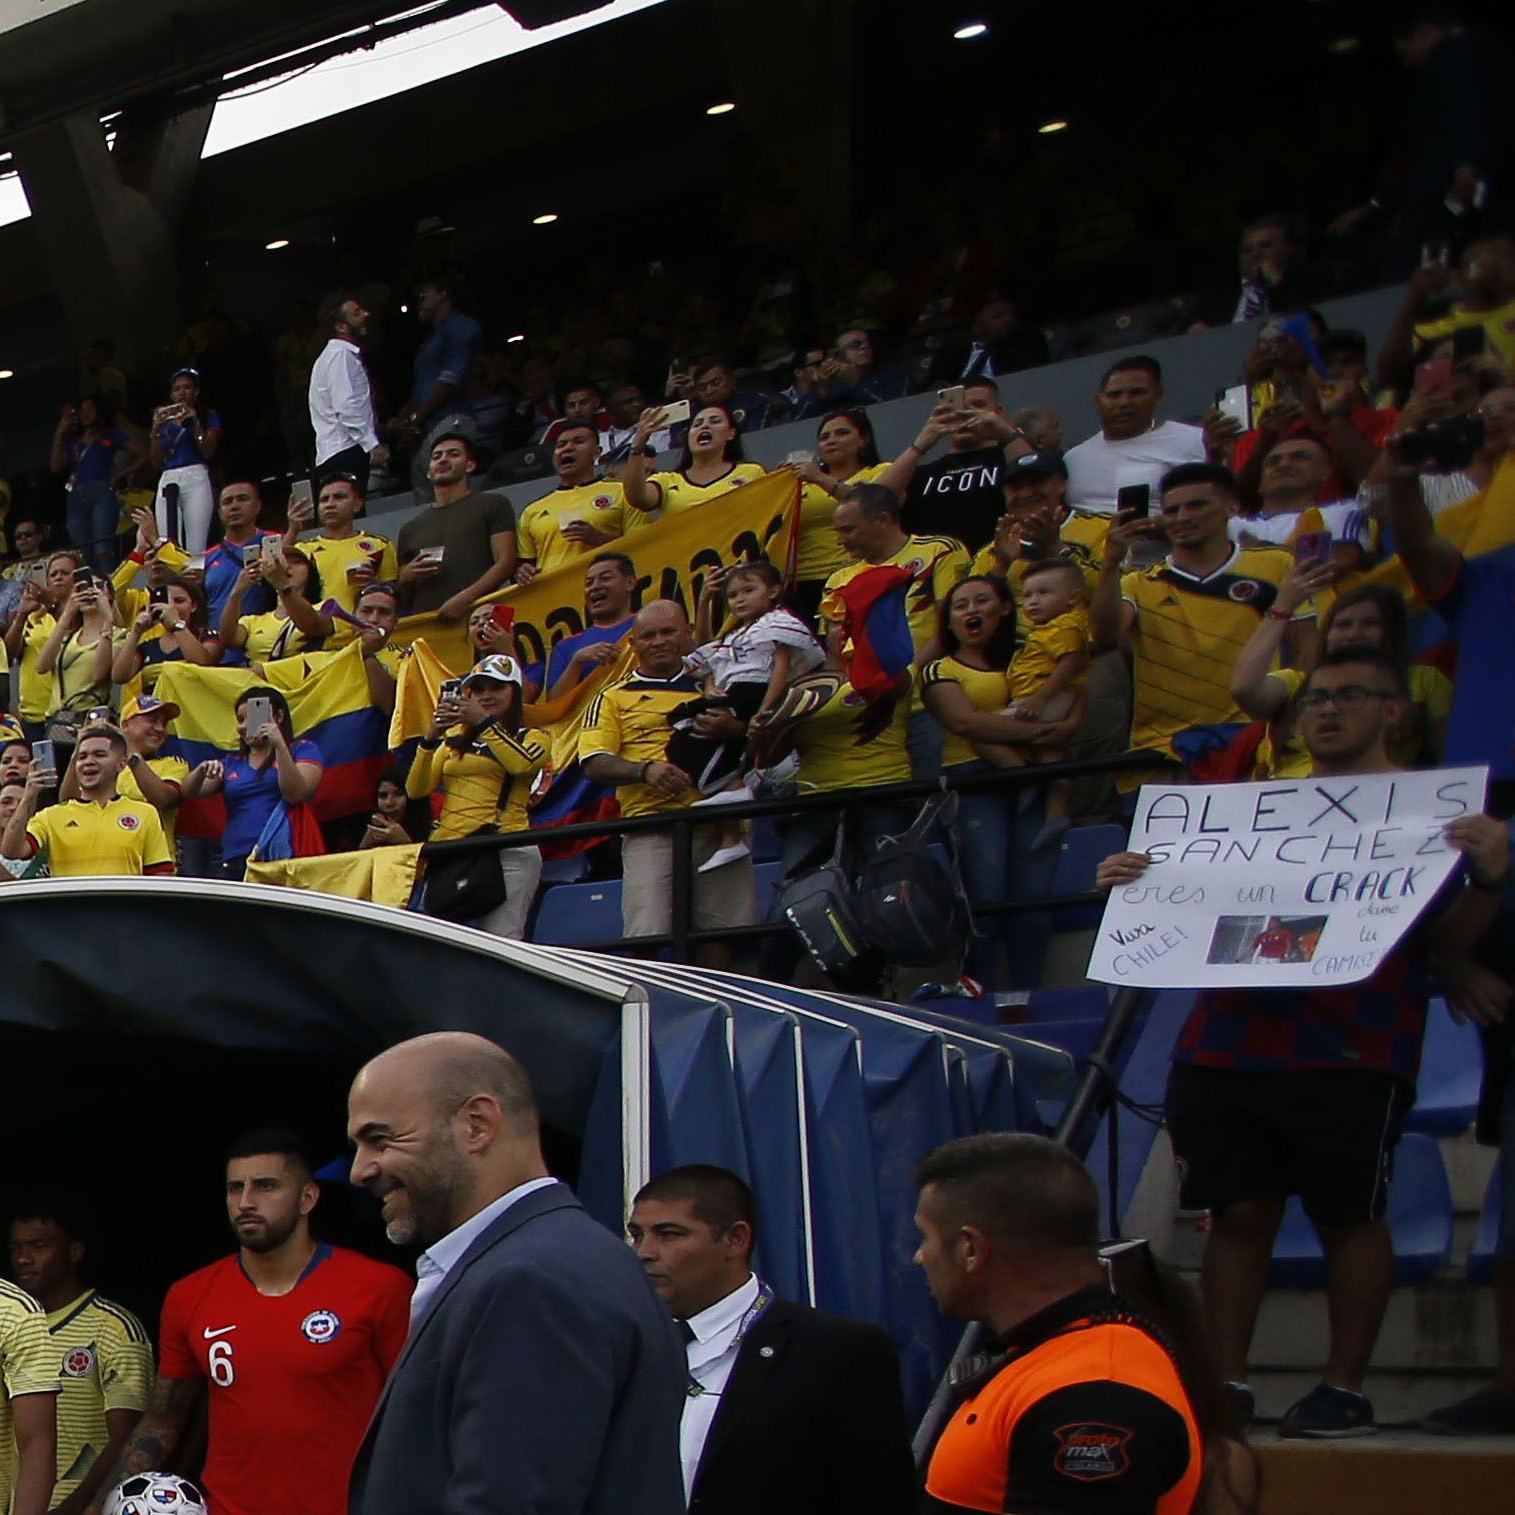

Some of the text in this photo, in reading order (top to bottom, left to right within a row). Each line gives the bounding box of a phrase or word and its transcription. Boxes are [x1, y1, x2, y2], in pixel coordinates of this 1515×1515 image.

[922, 467, 998, 496] ICON
[1145, 782, 1469, 834] ALEXIS
[1145, 825, 1446, 865] SANCHEZ
[1122, 867, 1427, 905] eres un CRACK
[209, 1340, 234, 1387] 6
